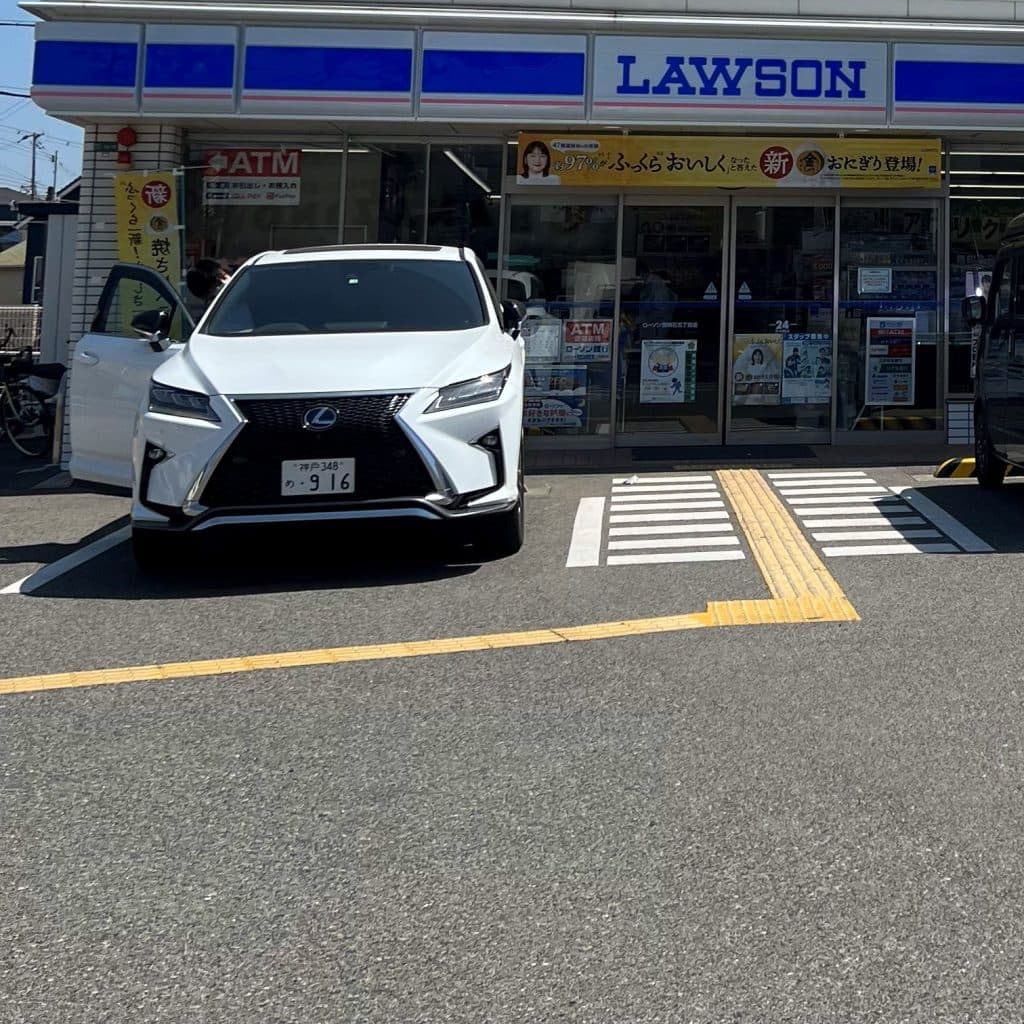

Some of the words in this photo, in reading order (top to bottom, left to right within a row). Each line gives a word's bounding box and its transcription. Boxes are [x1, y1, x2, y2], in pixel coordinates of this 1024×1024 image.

[617, 55, 866, 98] LAWSON
[228, 152, 298, 174] ATM
[763, 150, 789, 174] 新
[827, 154, 923, 172] おにぎり登場!
[571, 323, 605, 335] ATM
[775, 320, 790, 330] 24
